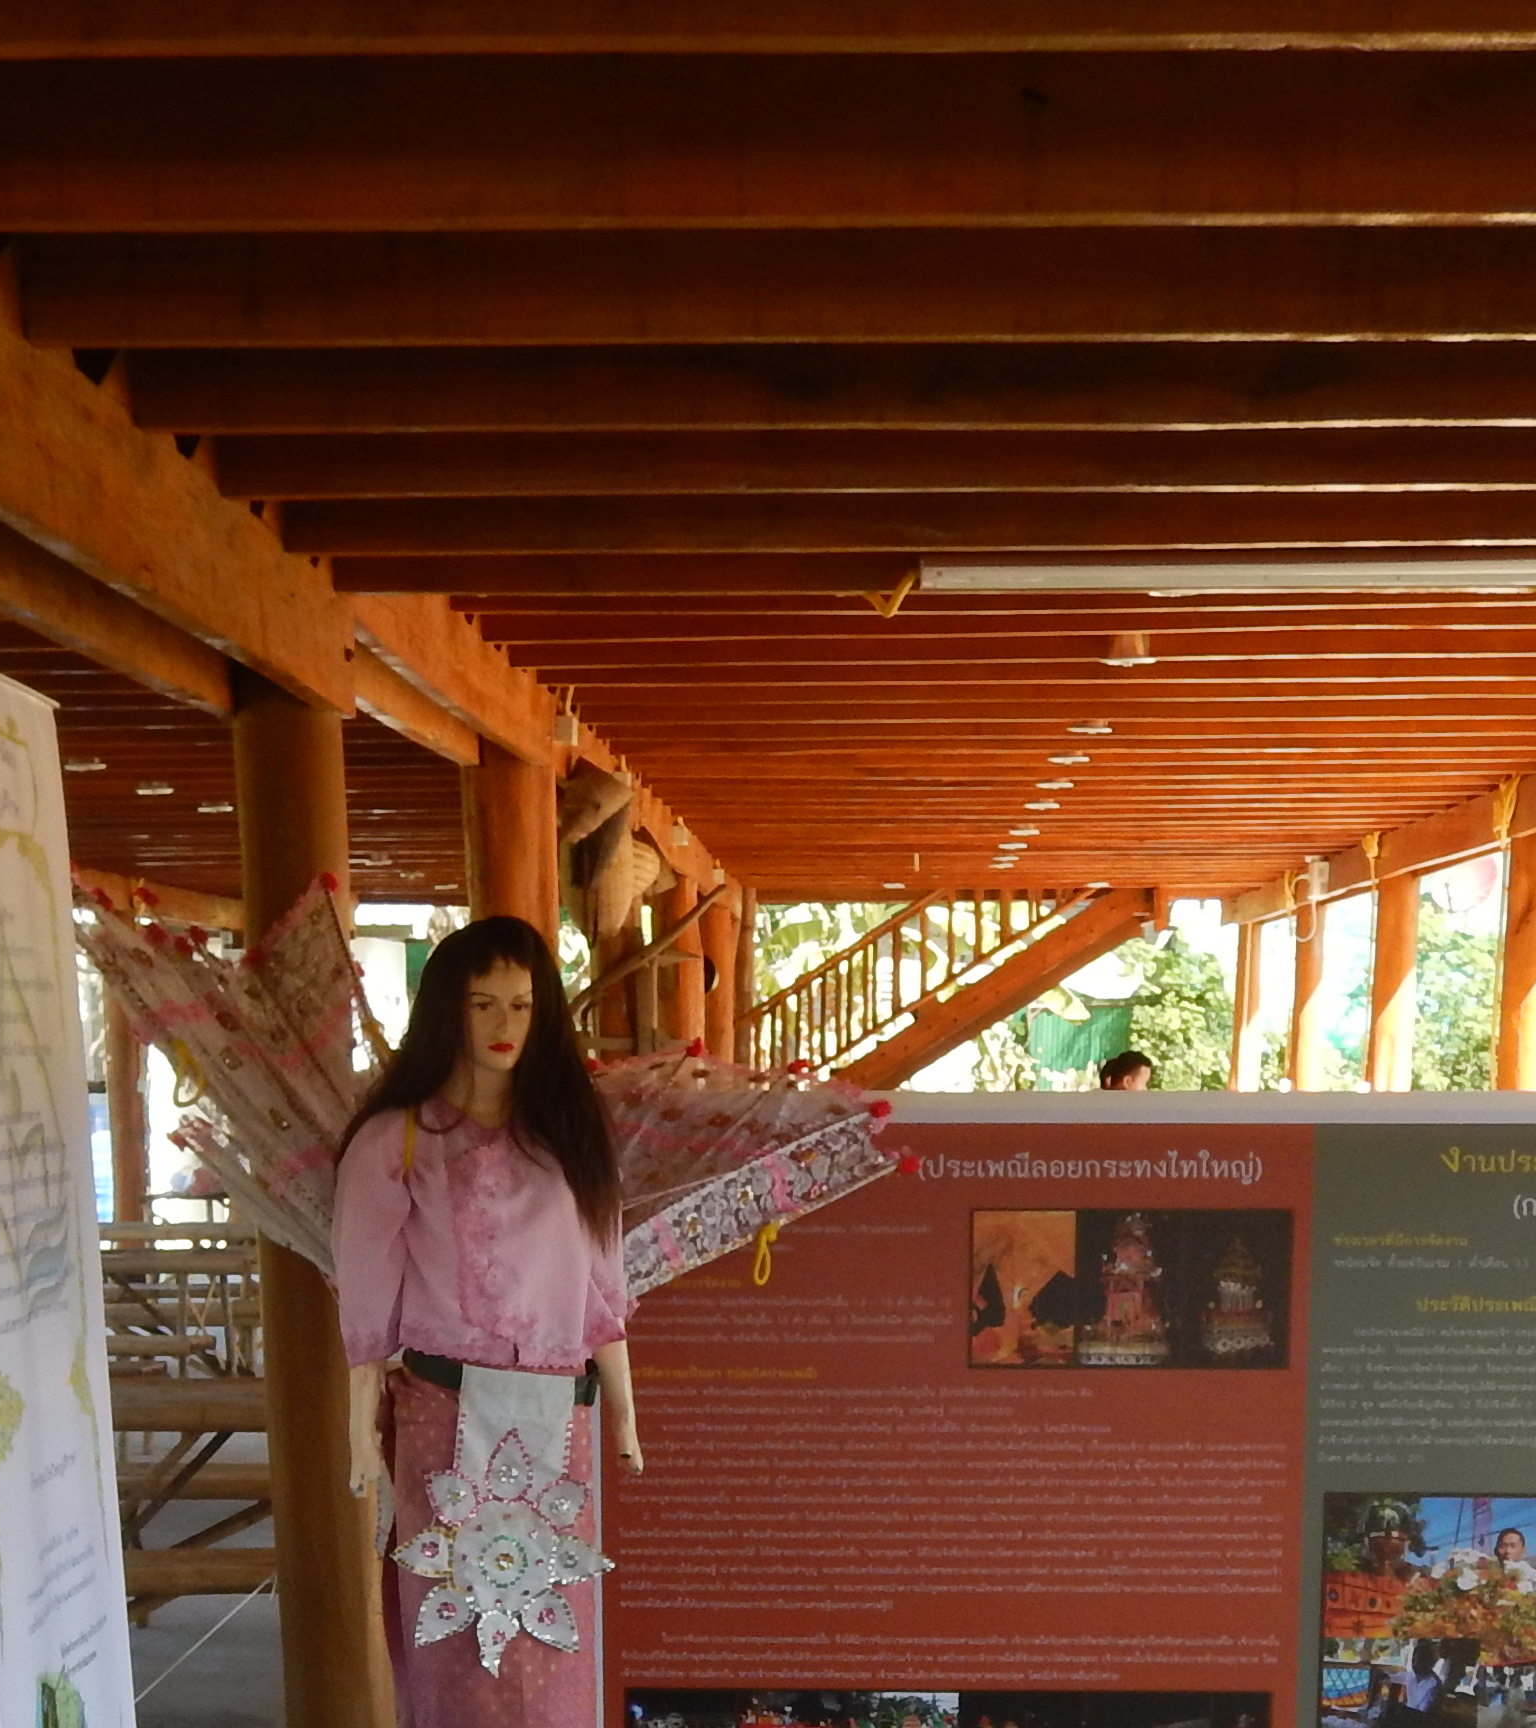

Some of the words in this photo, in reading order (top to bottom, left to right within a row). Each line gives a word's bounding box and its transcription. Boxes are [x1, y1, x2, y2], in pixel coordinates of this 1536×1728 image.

[917, 1150, 1264, 1186] (ประเพณีลอยกระทงไทใหญ่)
